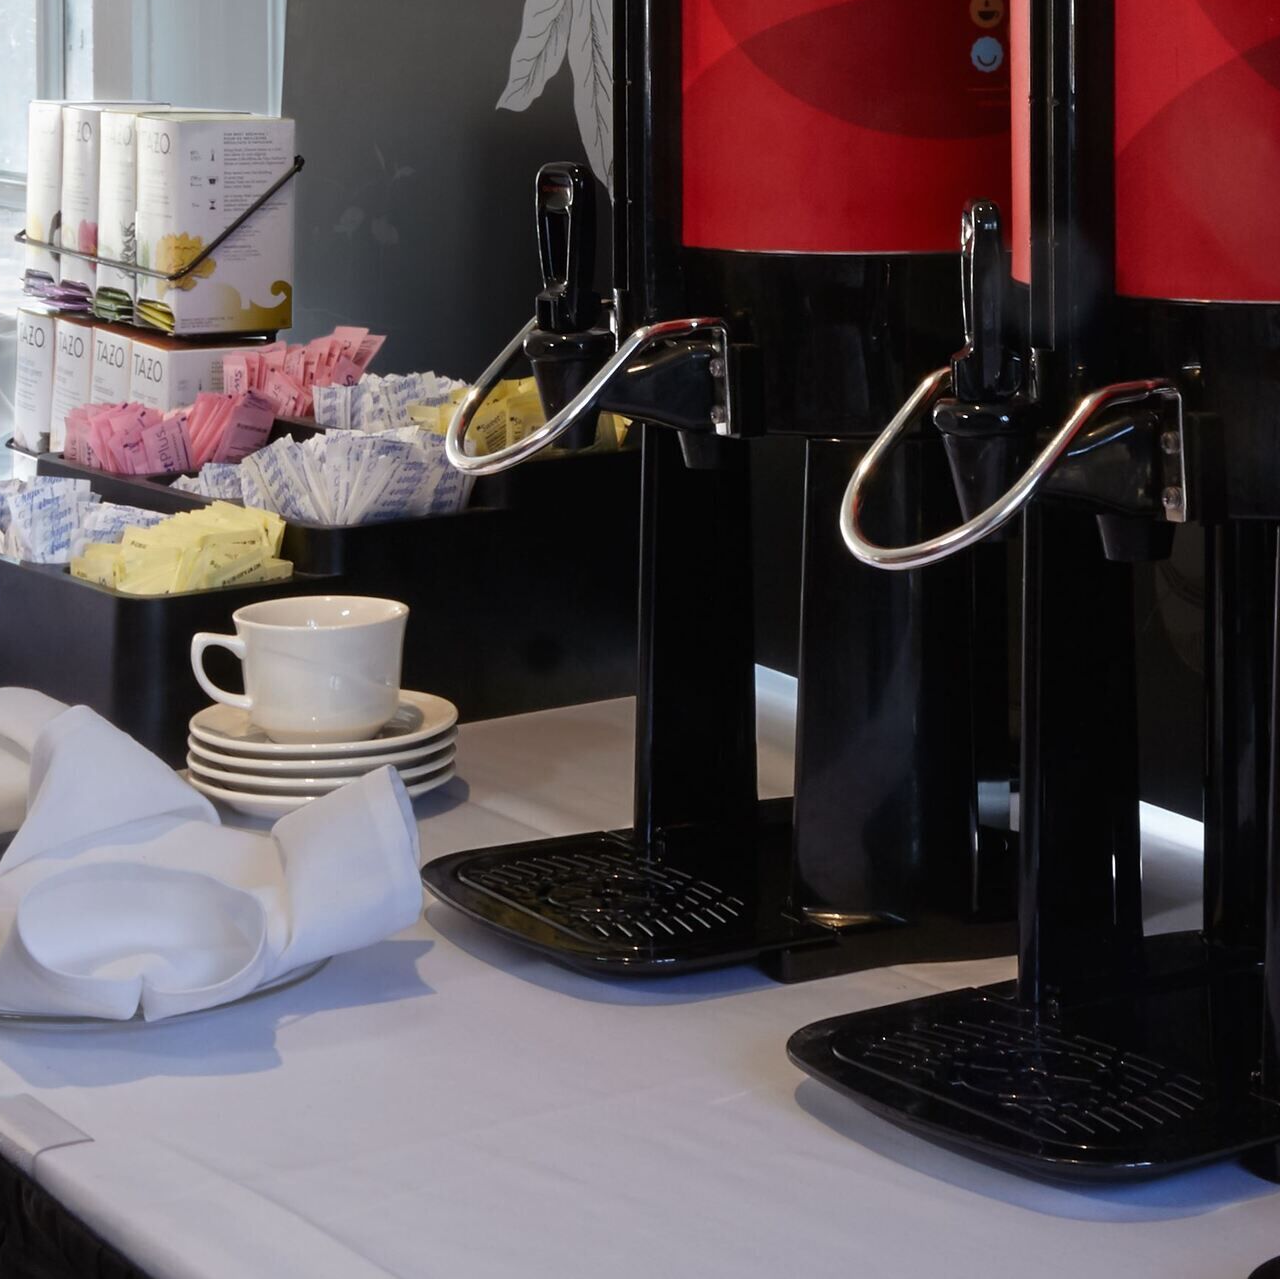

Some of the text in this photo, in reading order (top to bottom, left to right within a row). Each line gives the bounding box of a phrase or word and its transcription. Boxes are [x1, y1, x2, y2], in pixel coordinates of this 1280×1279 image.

[58, 331, 86, 360] TAZO
[96, 340, 125, 369] TAZO
[133, 354, 164, 384] TAZO
